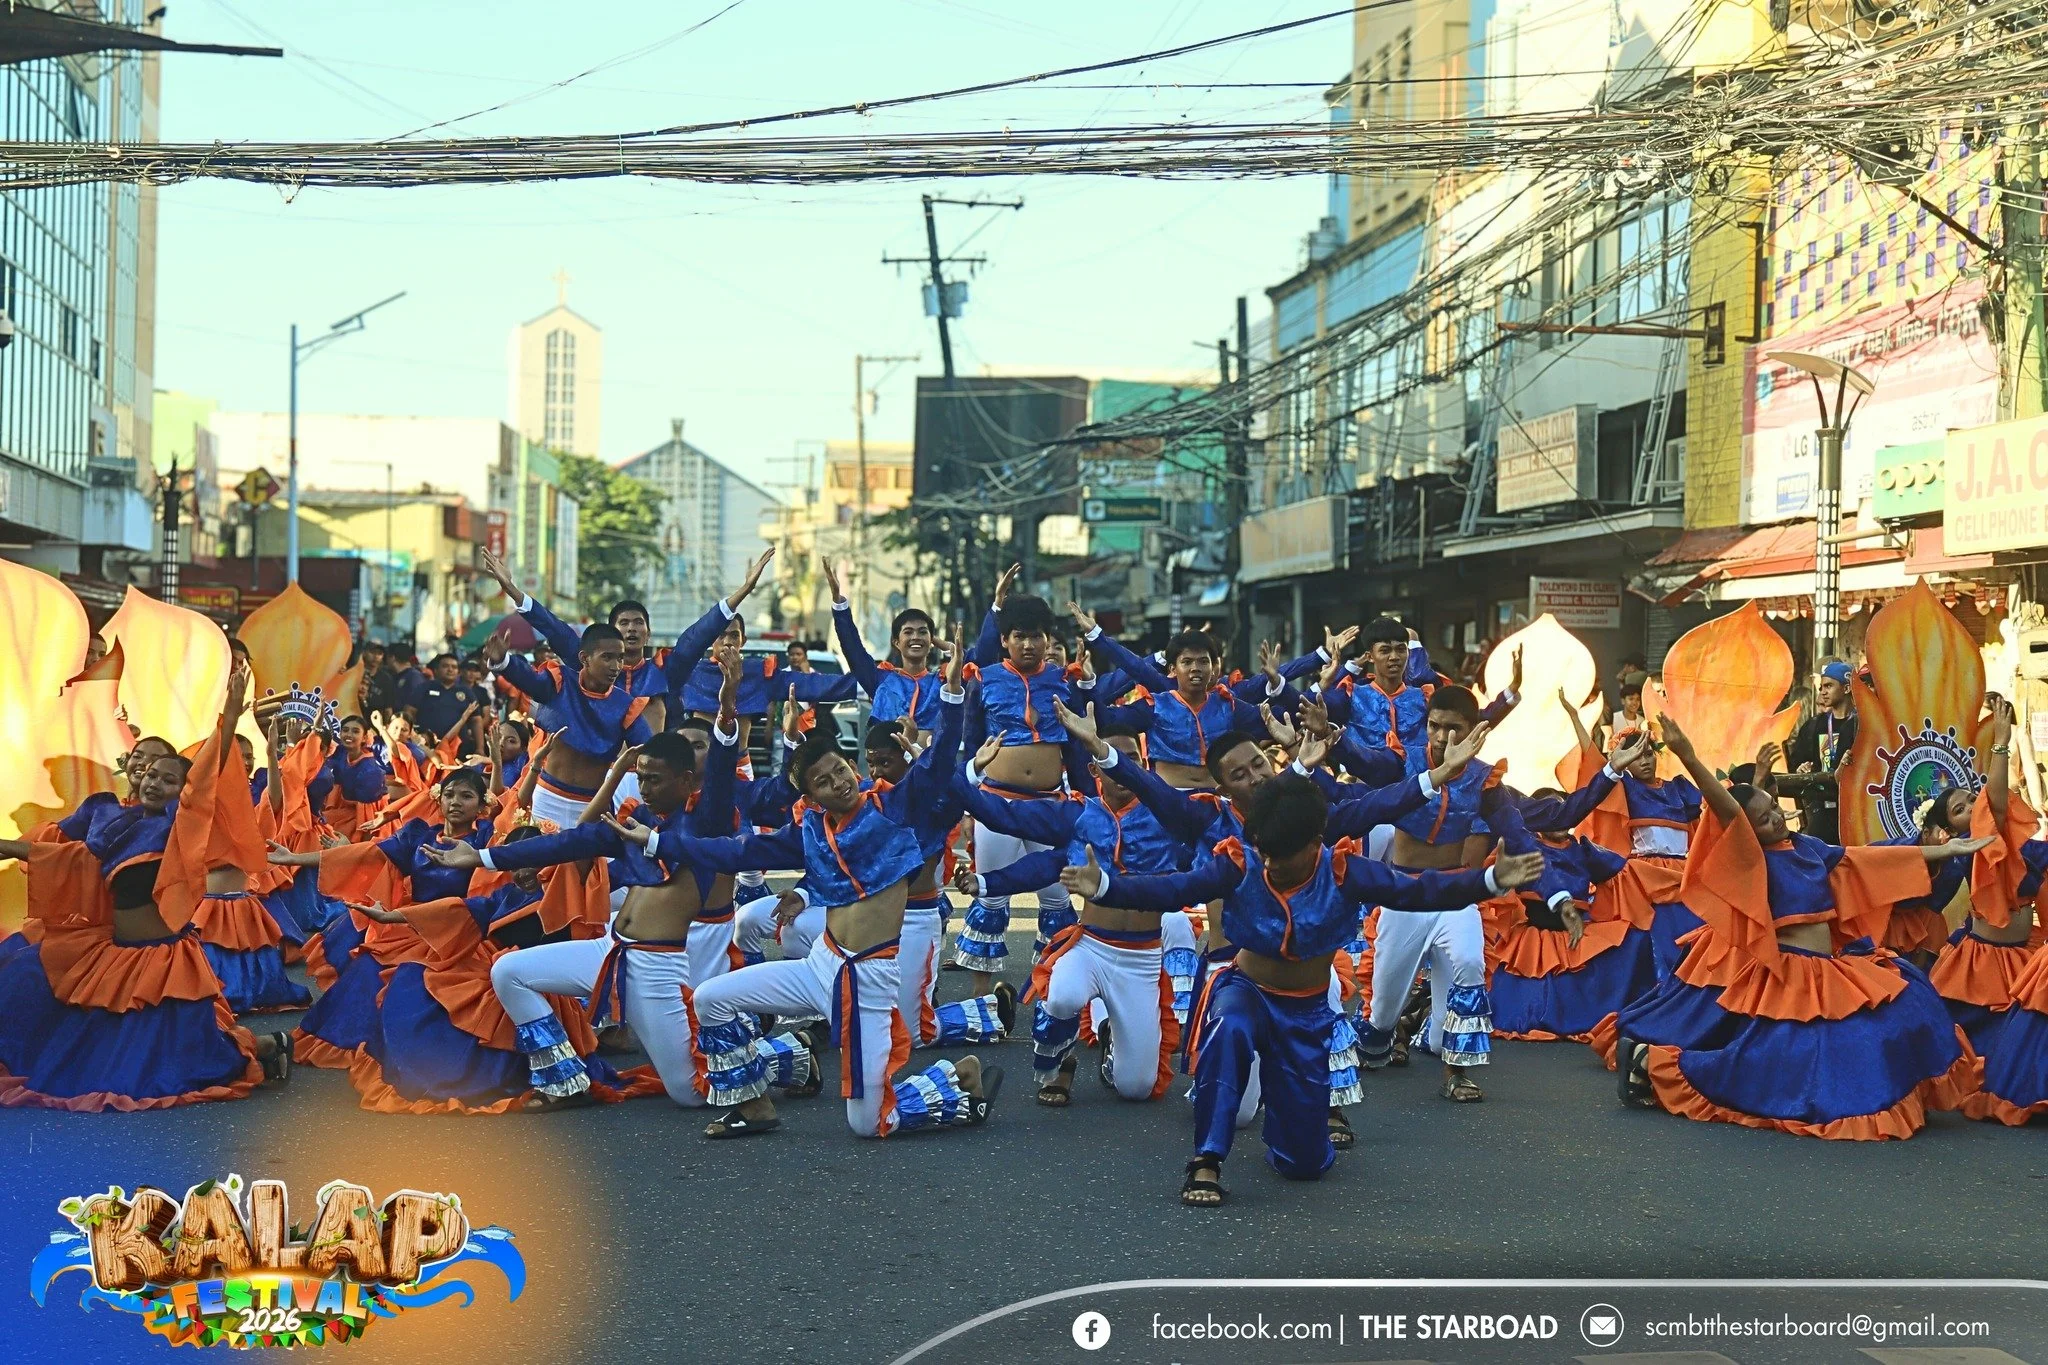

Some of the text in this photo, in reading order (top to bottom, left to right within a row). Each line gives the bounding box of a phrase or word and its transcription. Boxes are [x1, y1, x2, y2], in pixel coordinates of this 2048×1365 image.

[1794, 434, 1808, 458] LG
[1955, 505, 2038, 543] CELLPHONE
[1907, 748, 1934, 766] MARITIME,
[1934, 750, 1957, 771] BUSINESS
[1893, 768, 1907, 799] COLLEGE
[1955, 770, 1965, 784] AND
[1894, 799, 1918, 837] UTHWESTERN
